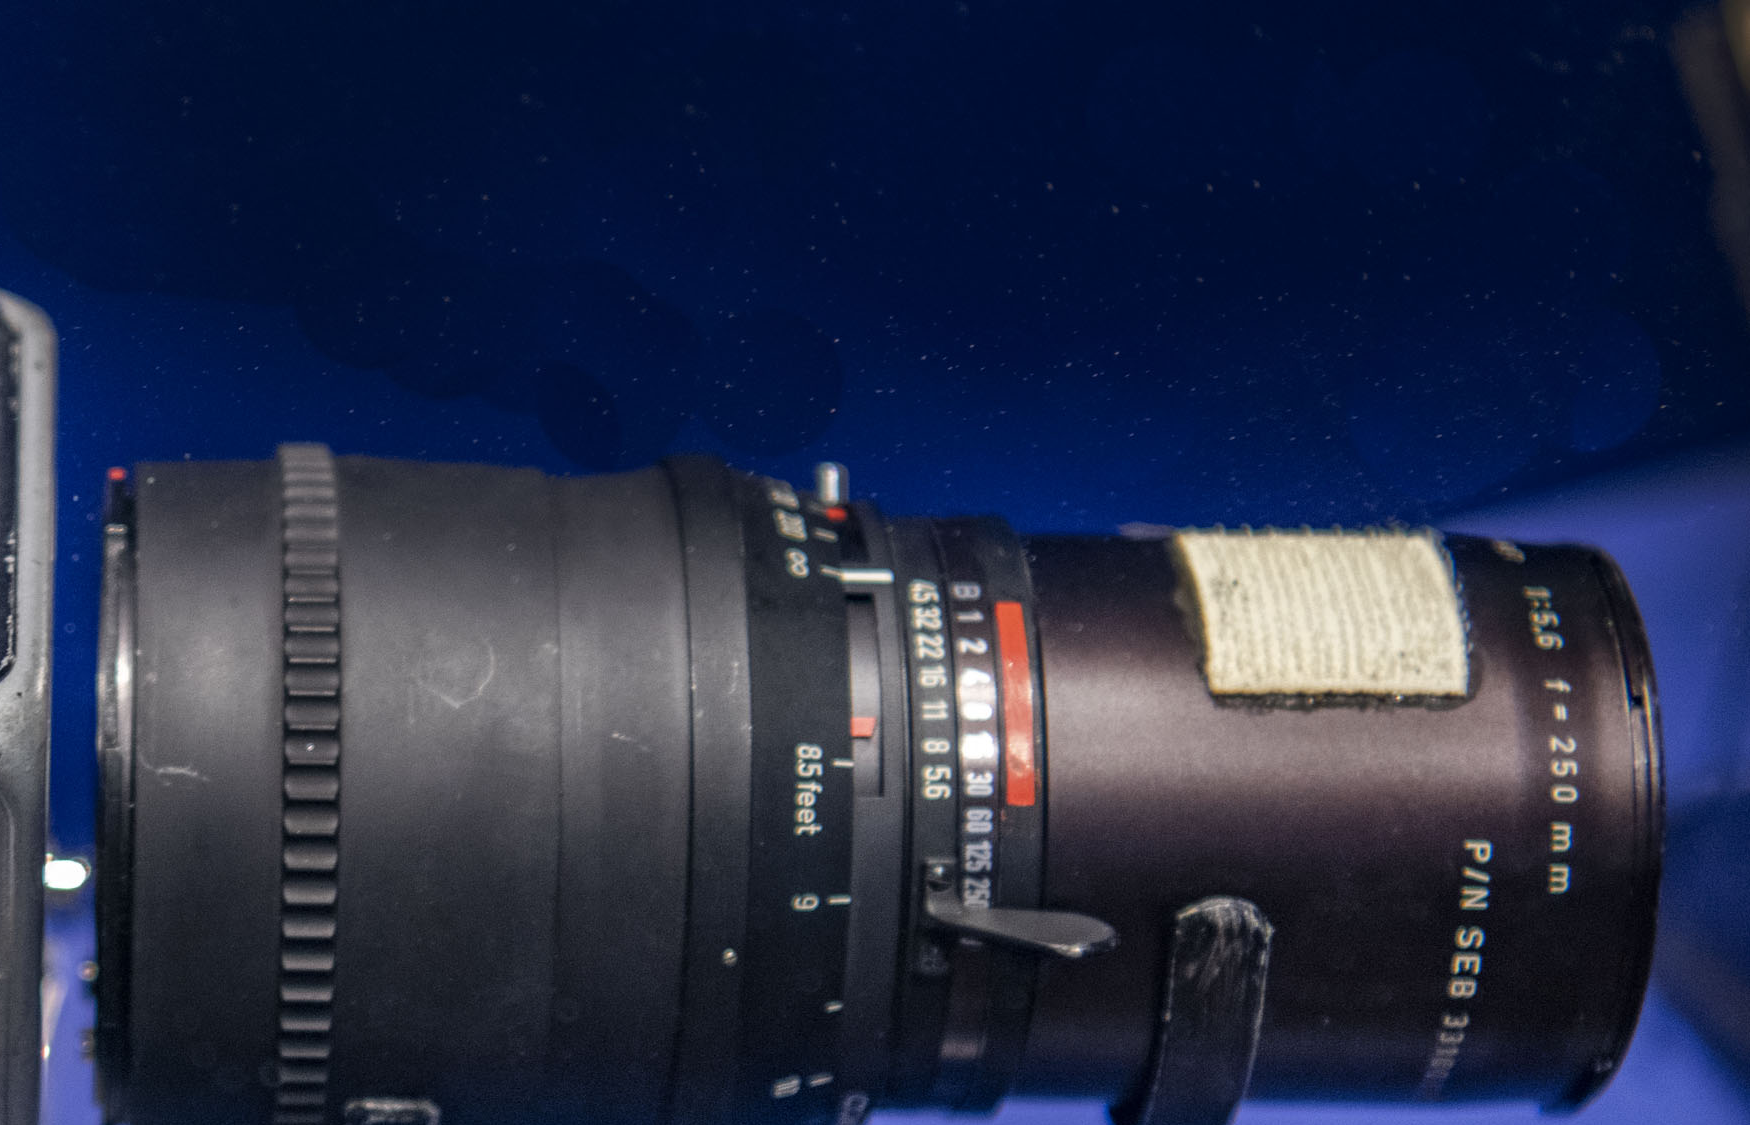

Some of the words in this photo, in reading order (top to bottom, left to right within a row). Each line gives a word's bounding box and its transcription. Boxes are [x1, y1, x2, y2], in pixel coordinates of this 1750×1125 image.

[910, 606, 943, 630] 32
[956, 611, 984, 623] 1
[914, 634, 946, 660] 22
[957, 637, 988, 655] 2
[919, 665, 948, 688] 16
[921, 701, 948, 720] 11
[922, 738, 950, 754] 8
[795, 743, 823, 777] 8.5
[922, 765, 952, 800] 5.6
[964, 770, 994, 796] 30
[794, 781, 823, 836] feet
[964, 807, 993, 833] 60
[963, 840, 993, 872] 125
[1459, 839, 1493, 911] P/N
[791, 894, 820, 912] 9
[1448, 925, 1486, 999] SEB
